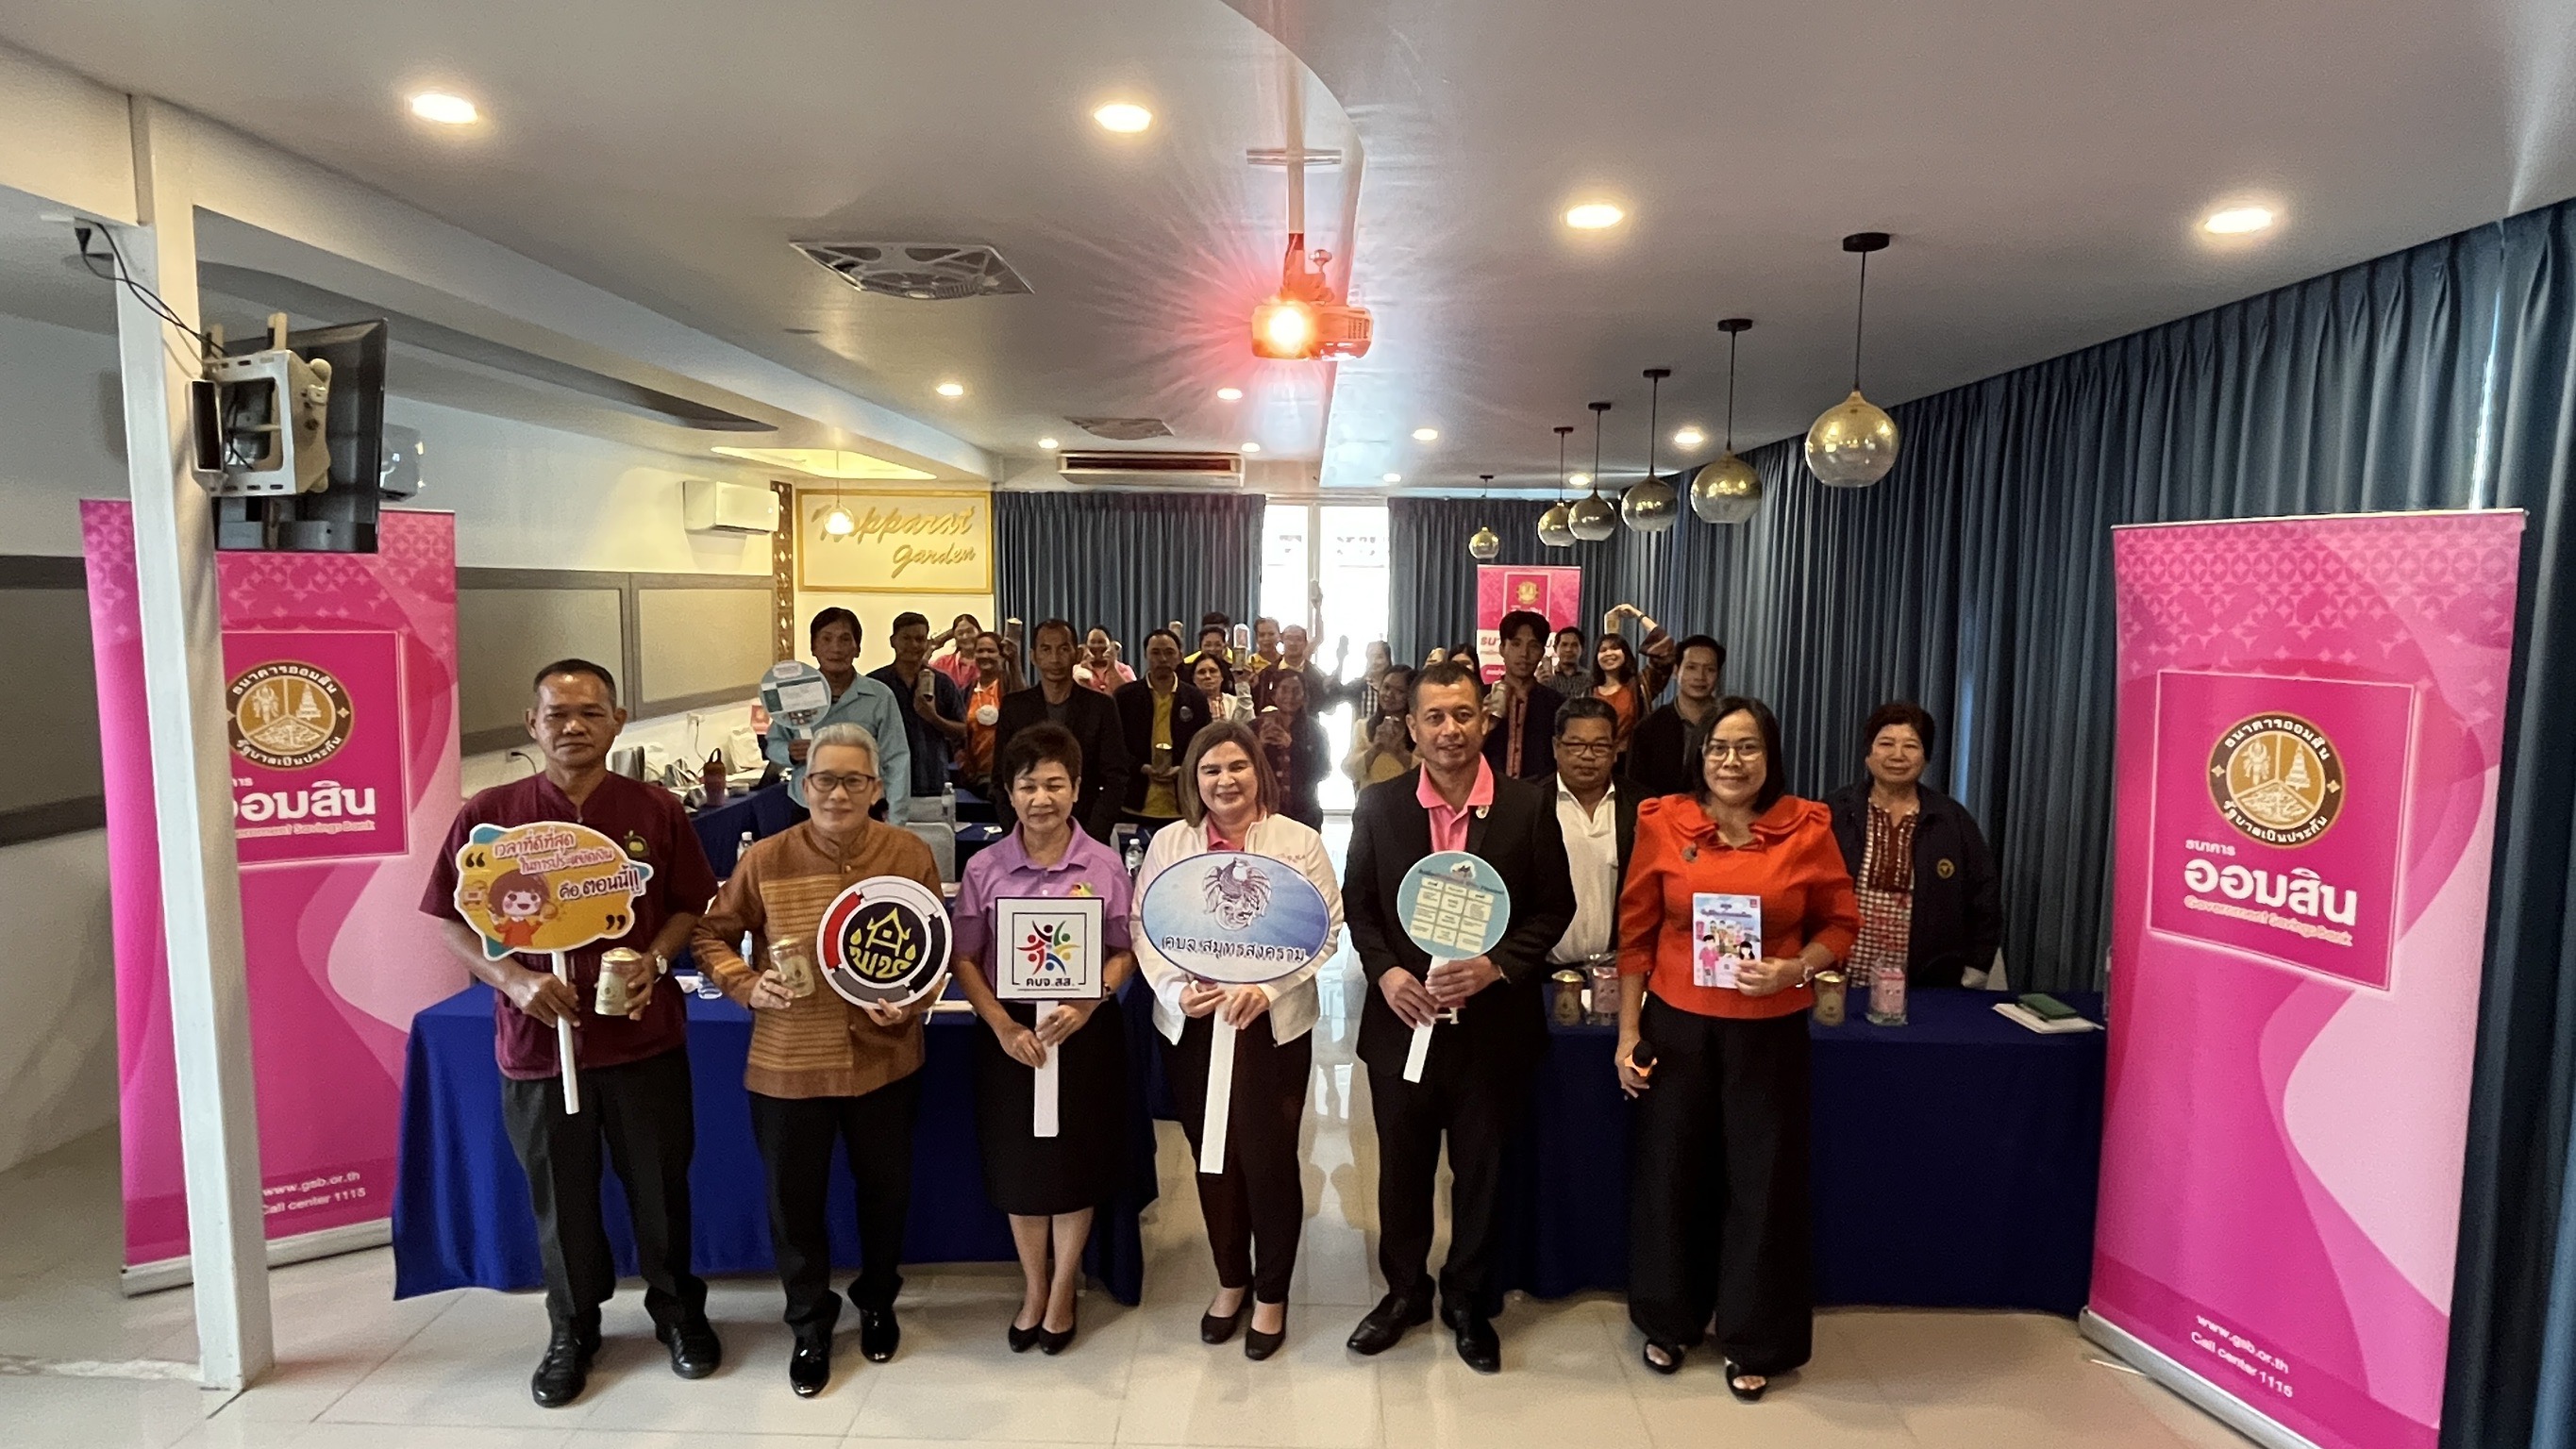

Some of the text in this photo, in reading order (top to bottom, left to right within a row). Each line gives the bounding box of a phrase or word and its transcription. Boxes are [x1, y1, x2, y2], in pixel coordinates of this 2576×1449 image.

[232, 779, 376, 822] อมสิน
[559, 882, 579, 899] คือ
[2183, 858, 2358, 927] ออมสิน
